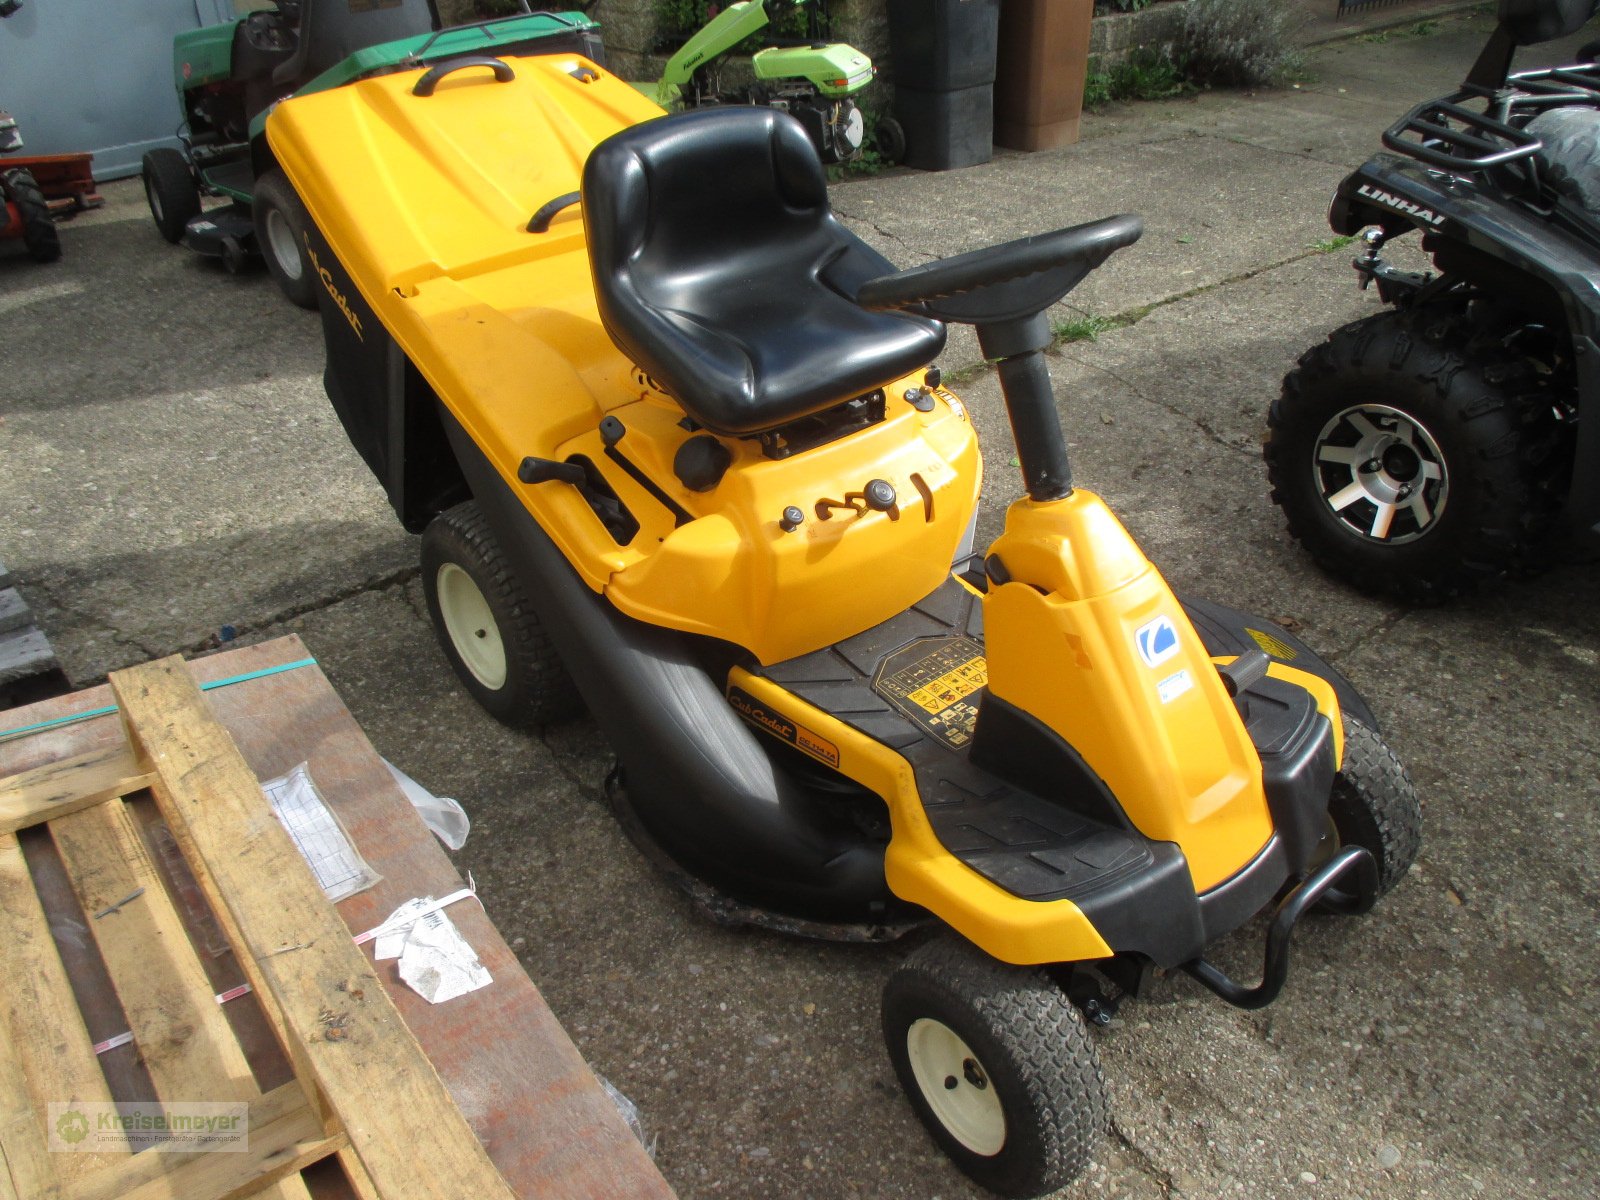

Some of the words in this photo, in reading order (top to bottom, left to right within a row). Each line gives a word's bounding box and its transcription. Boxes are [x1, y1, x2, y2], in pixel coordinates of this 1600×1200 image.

[1357, 184, 1446, 225] LINHAI
[729, 696, 752, 713] Cub
[752, 709, 792, 738] Cadet
